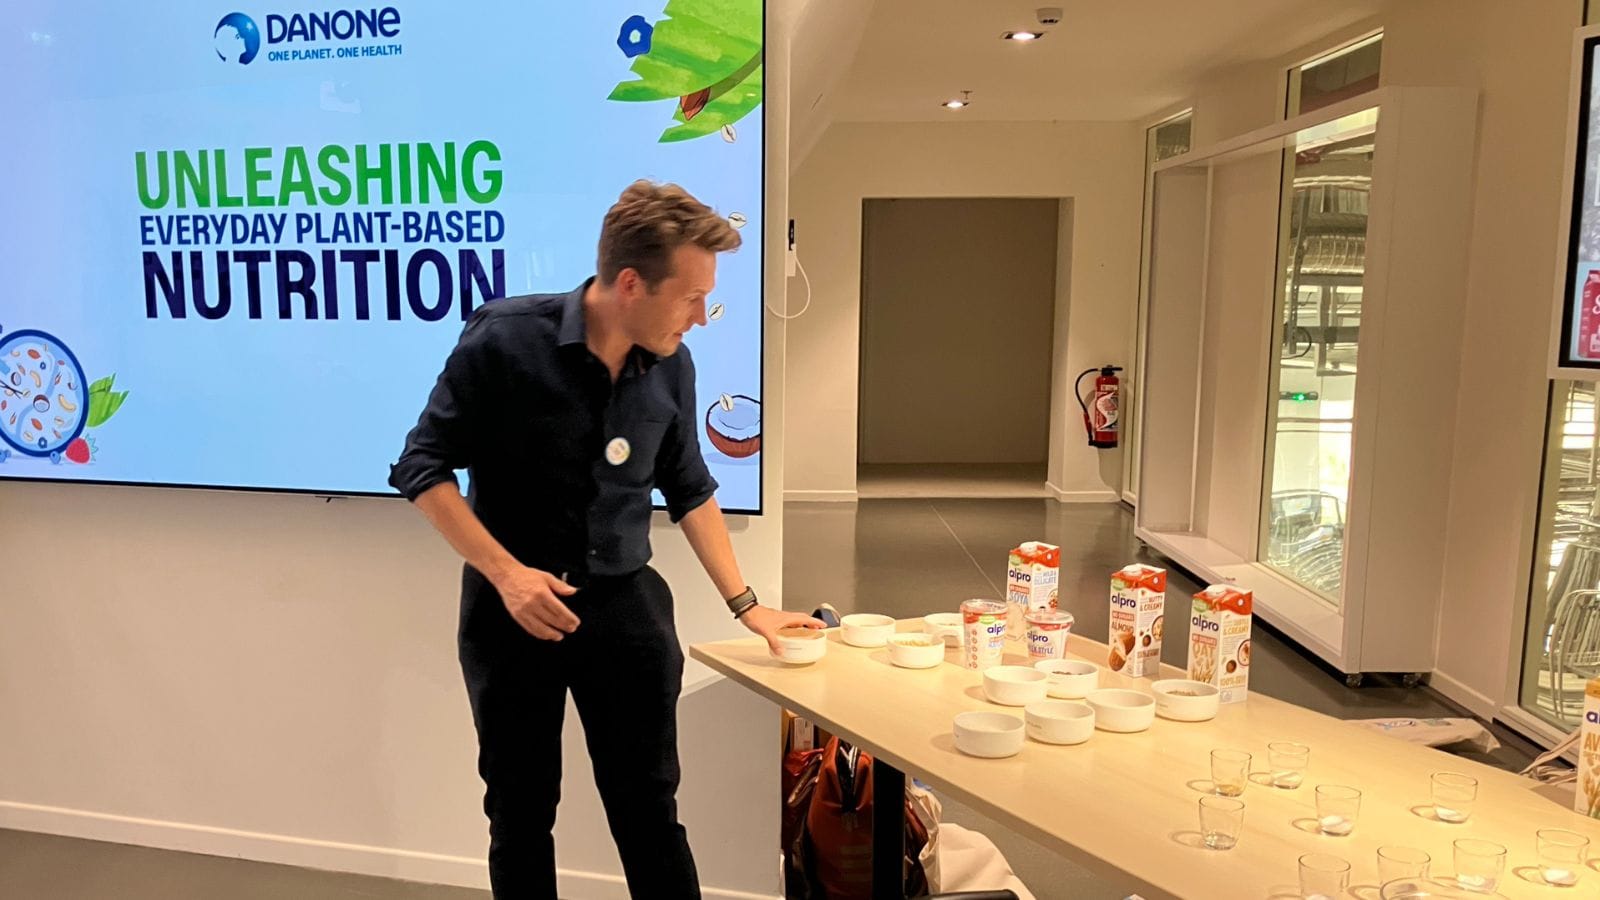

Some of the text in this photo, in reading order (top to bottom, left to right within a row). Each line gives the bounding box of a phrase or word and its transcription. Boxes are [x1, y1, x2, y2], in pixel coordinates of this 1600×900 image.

[268, 44, 402, 61] ONE PLANET. ONE HEALTH
[135, 140, 503, 210] UNLEASHING
[139, 210, 505, 245] EVERYDAY PLANT-BASED
[142, 248, 506, 322] NUTRITION
[1009, 568, 1031, 582] alpro
[1009, 592, 1029, 605] SOYA
[1112, 593, 1136, 608] alpro
[987, 624, 1005, 635] alpr
[1112, 621, 1134, 632] ALMOND
[1192, 615, 1219, 632] alpro
[1193, 643, 1216, 657] OAT
